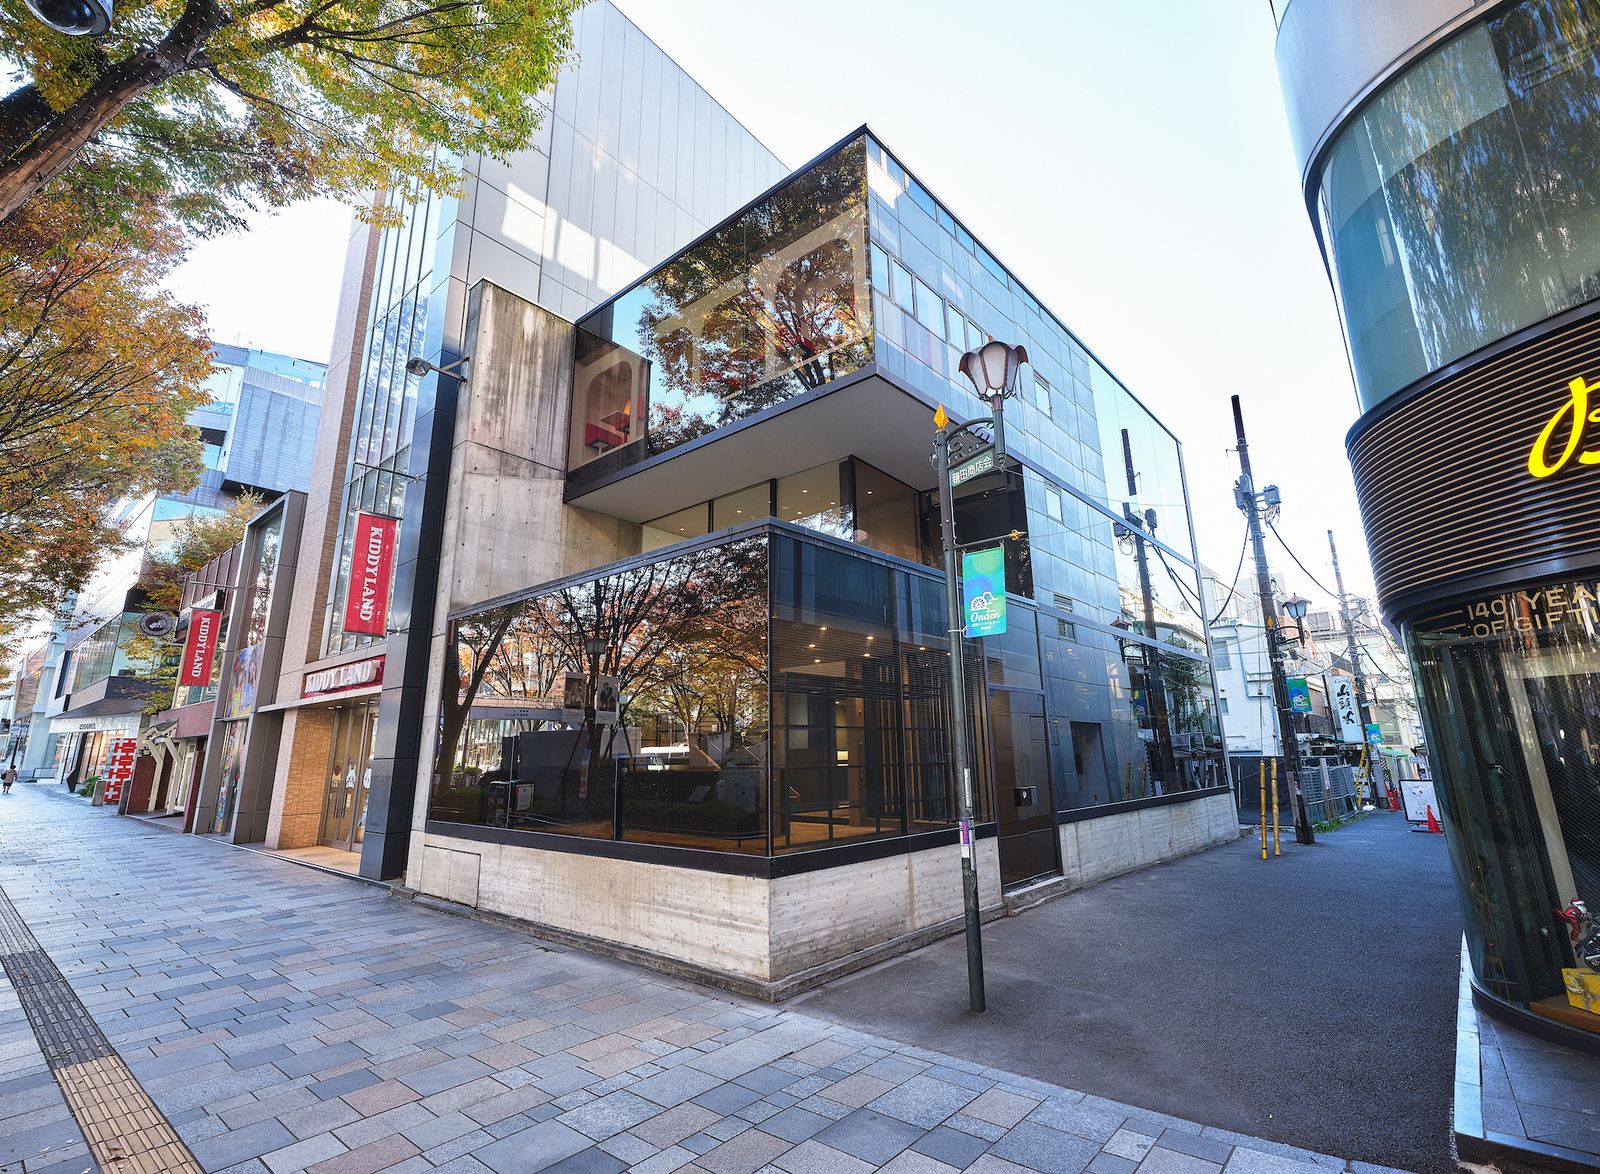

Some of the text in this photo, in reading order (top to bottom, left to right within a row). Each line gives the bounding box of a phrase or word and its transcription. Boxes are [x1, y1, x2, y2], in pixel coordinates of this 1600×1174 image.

[1467, 582, 1600, 621] 140 YEA
[970, 612, 1001, 622] Onden
[1473, 619, 1505, 638] OF
